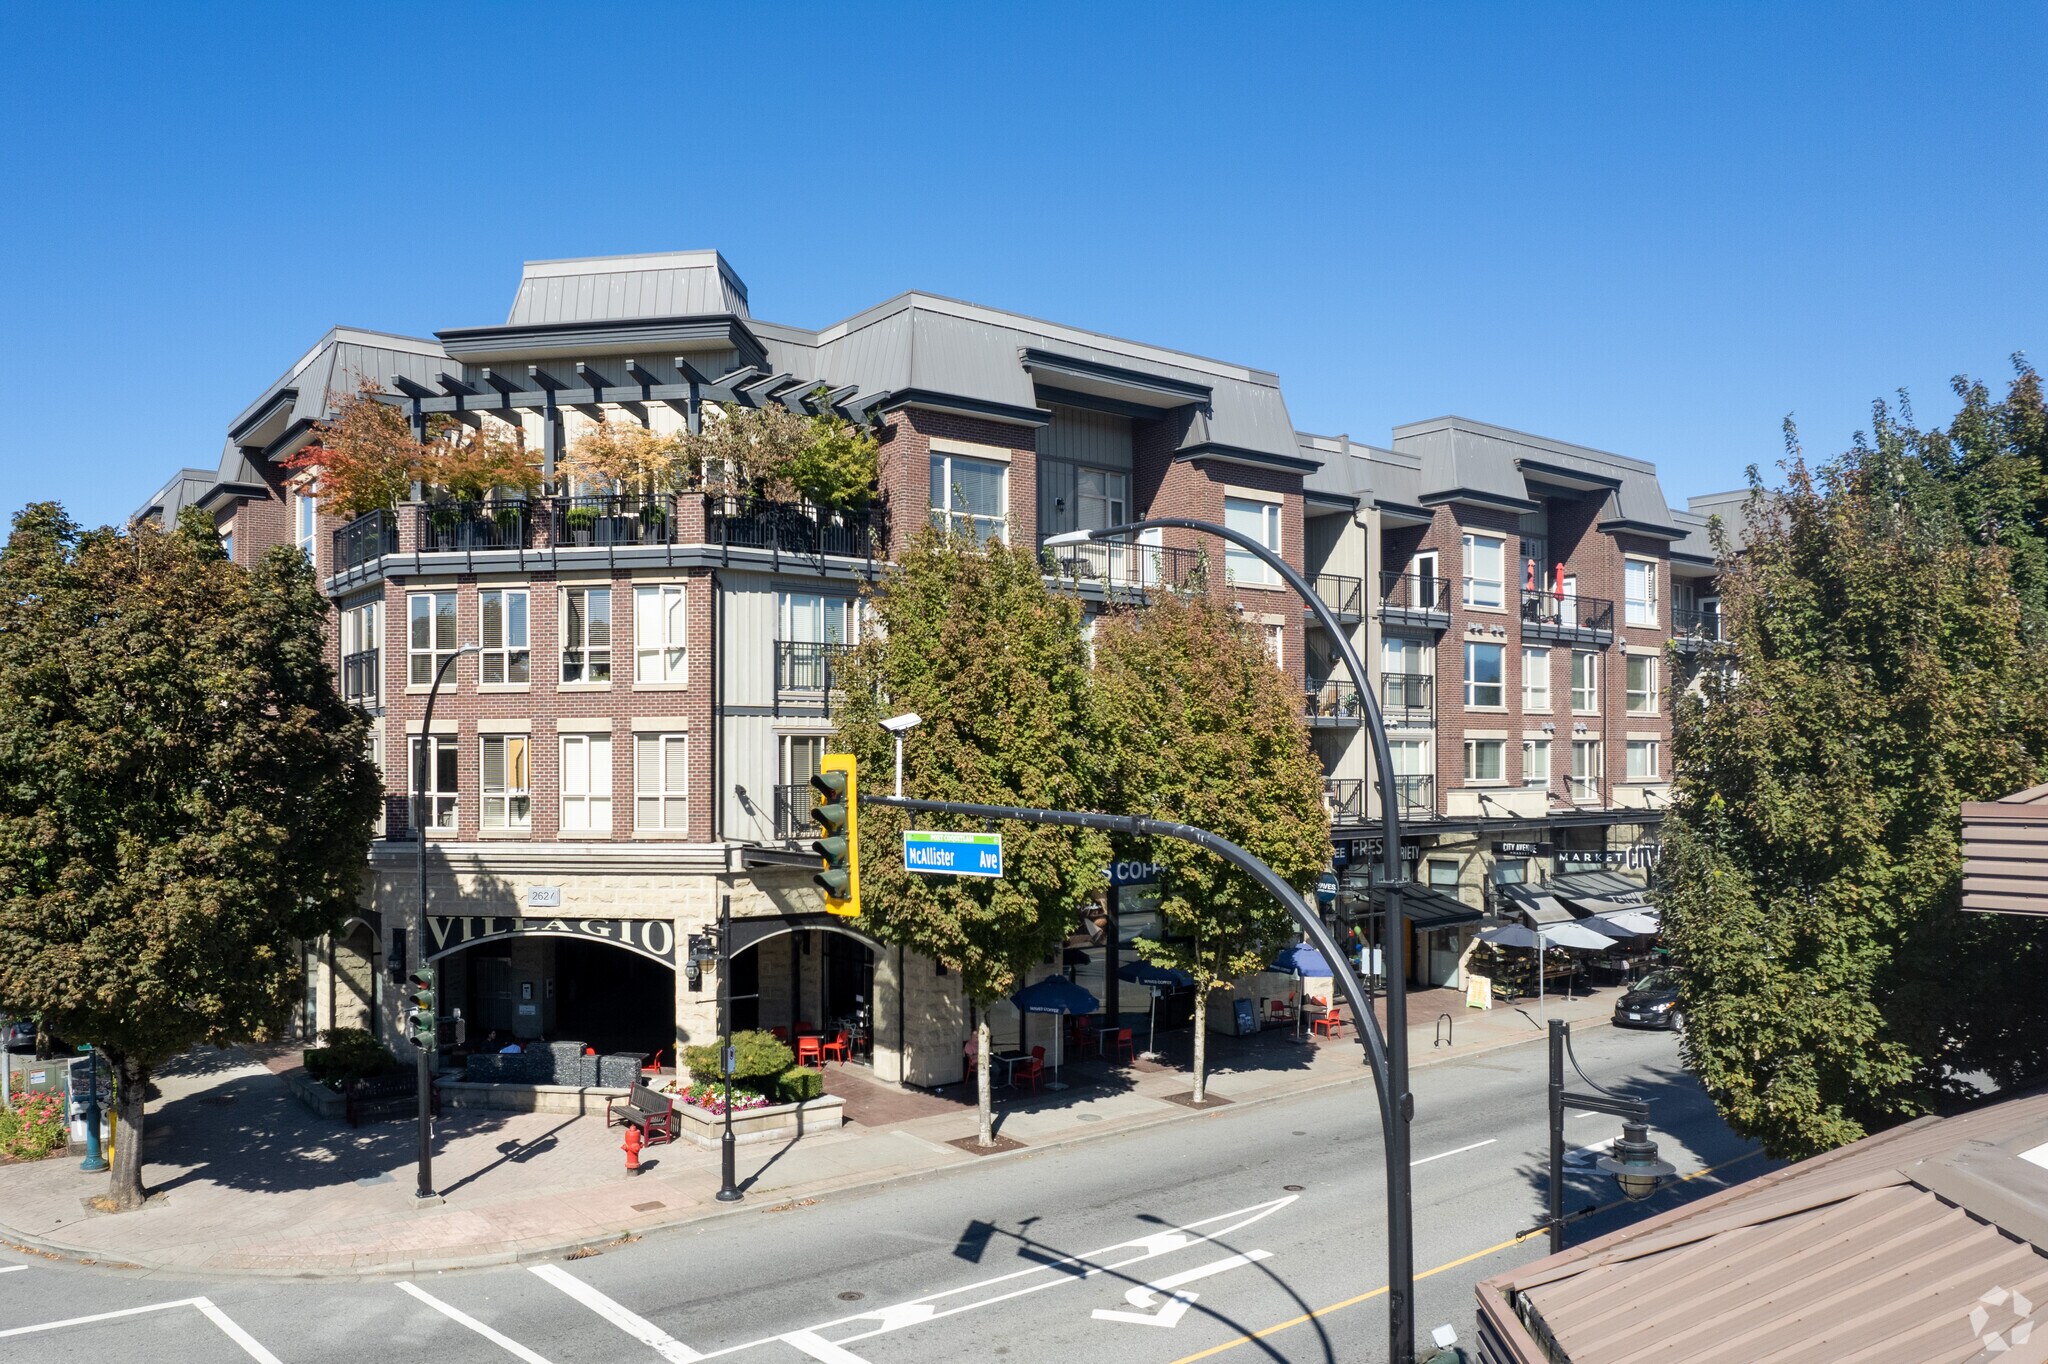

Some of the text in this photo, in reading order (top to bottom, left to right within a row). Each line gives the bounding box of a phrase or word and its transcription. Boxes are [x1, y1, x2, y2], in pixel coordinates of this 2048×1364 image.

[1351, 839, 1383, 857] FRES
[1401, 845, 1420, 860] RIETY
[1502, 843, 1515, 852] CITY
[909, 847, 998, 870] McAllister Ave
[1559, 852, 1623, 862] MARKET
[1116, 861, 1167, 880] COFF
[426, 916, 674, 956] VILLAGIO
